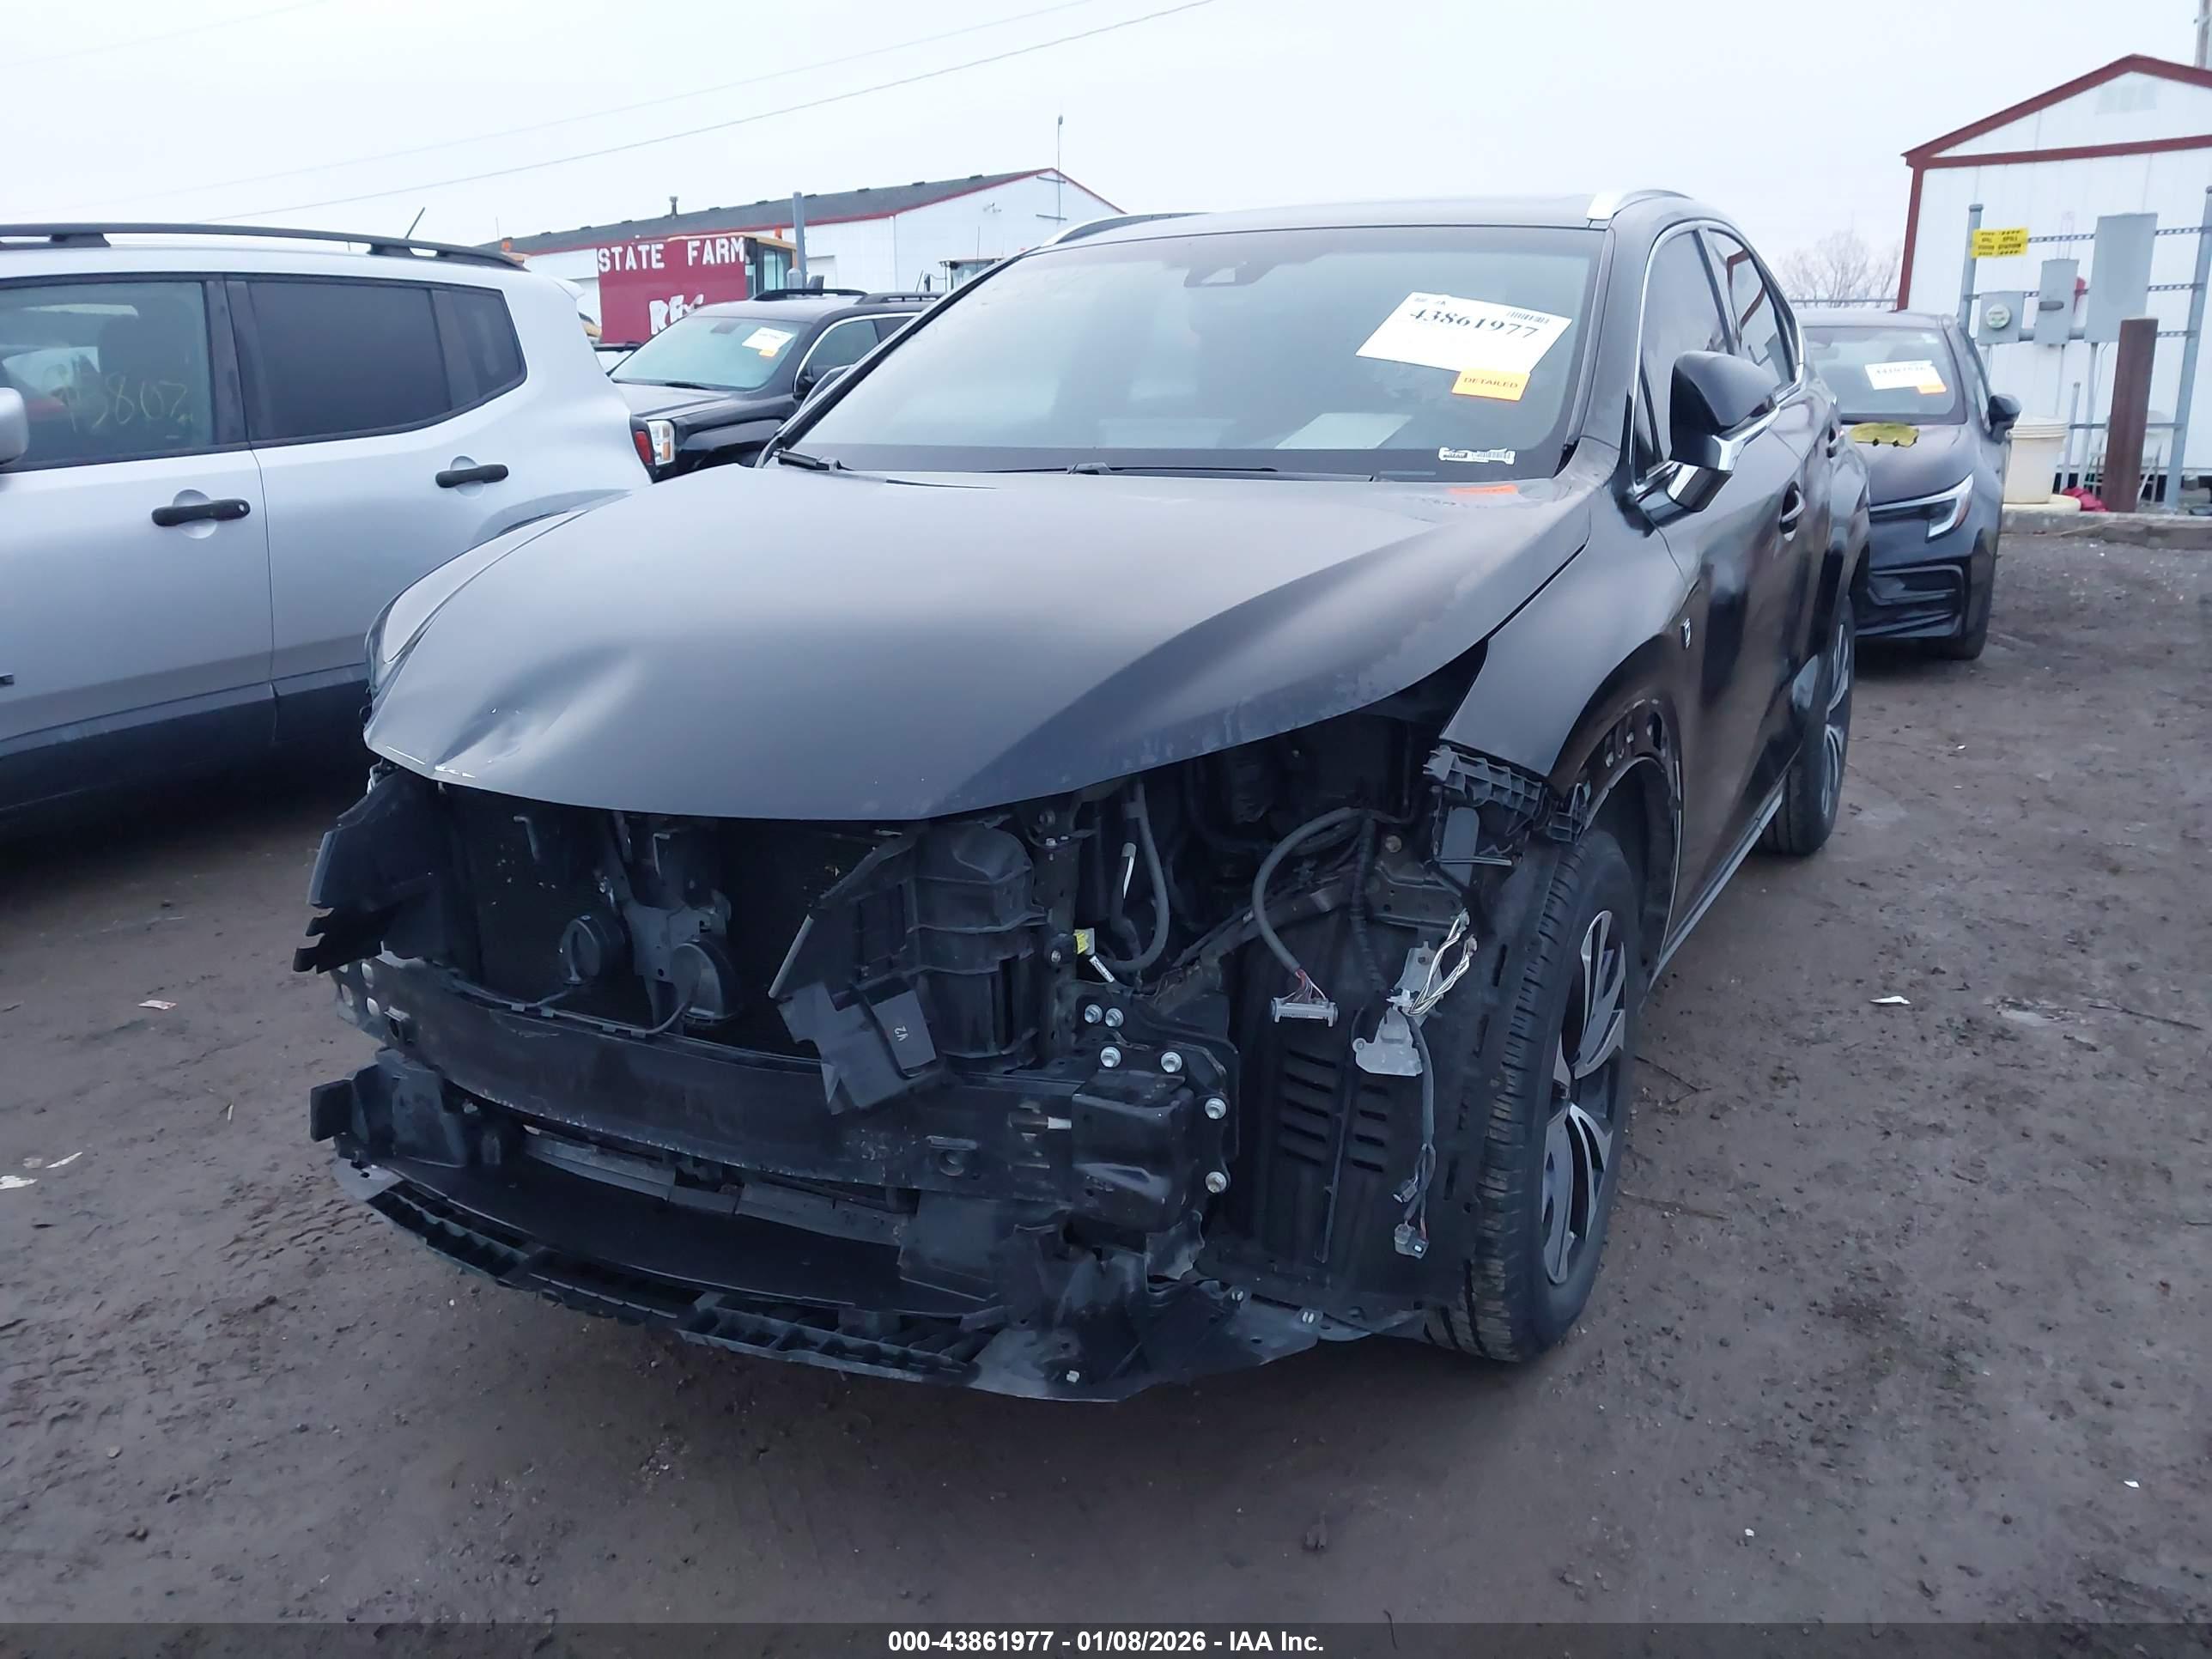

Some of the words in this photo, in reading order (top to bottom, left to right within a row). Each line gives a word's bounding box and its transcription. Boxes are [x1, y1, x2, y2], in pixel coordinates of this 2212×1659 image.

[598, 243, 665, 272] STATE
[688, 236, 745, 266] FARM
[1410, 308, 1540, 338] 43861977
[1463, 376, 1518, 389] DETAILED
